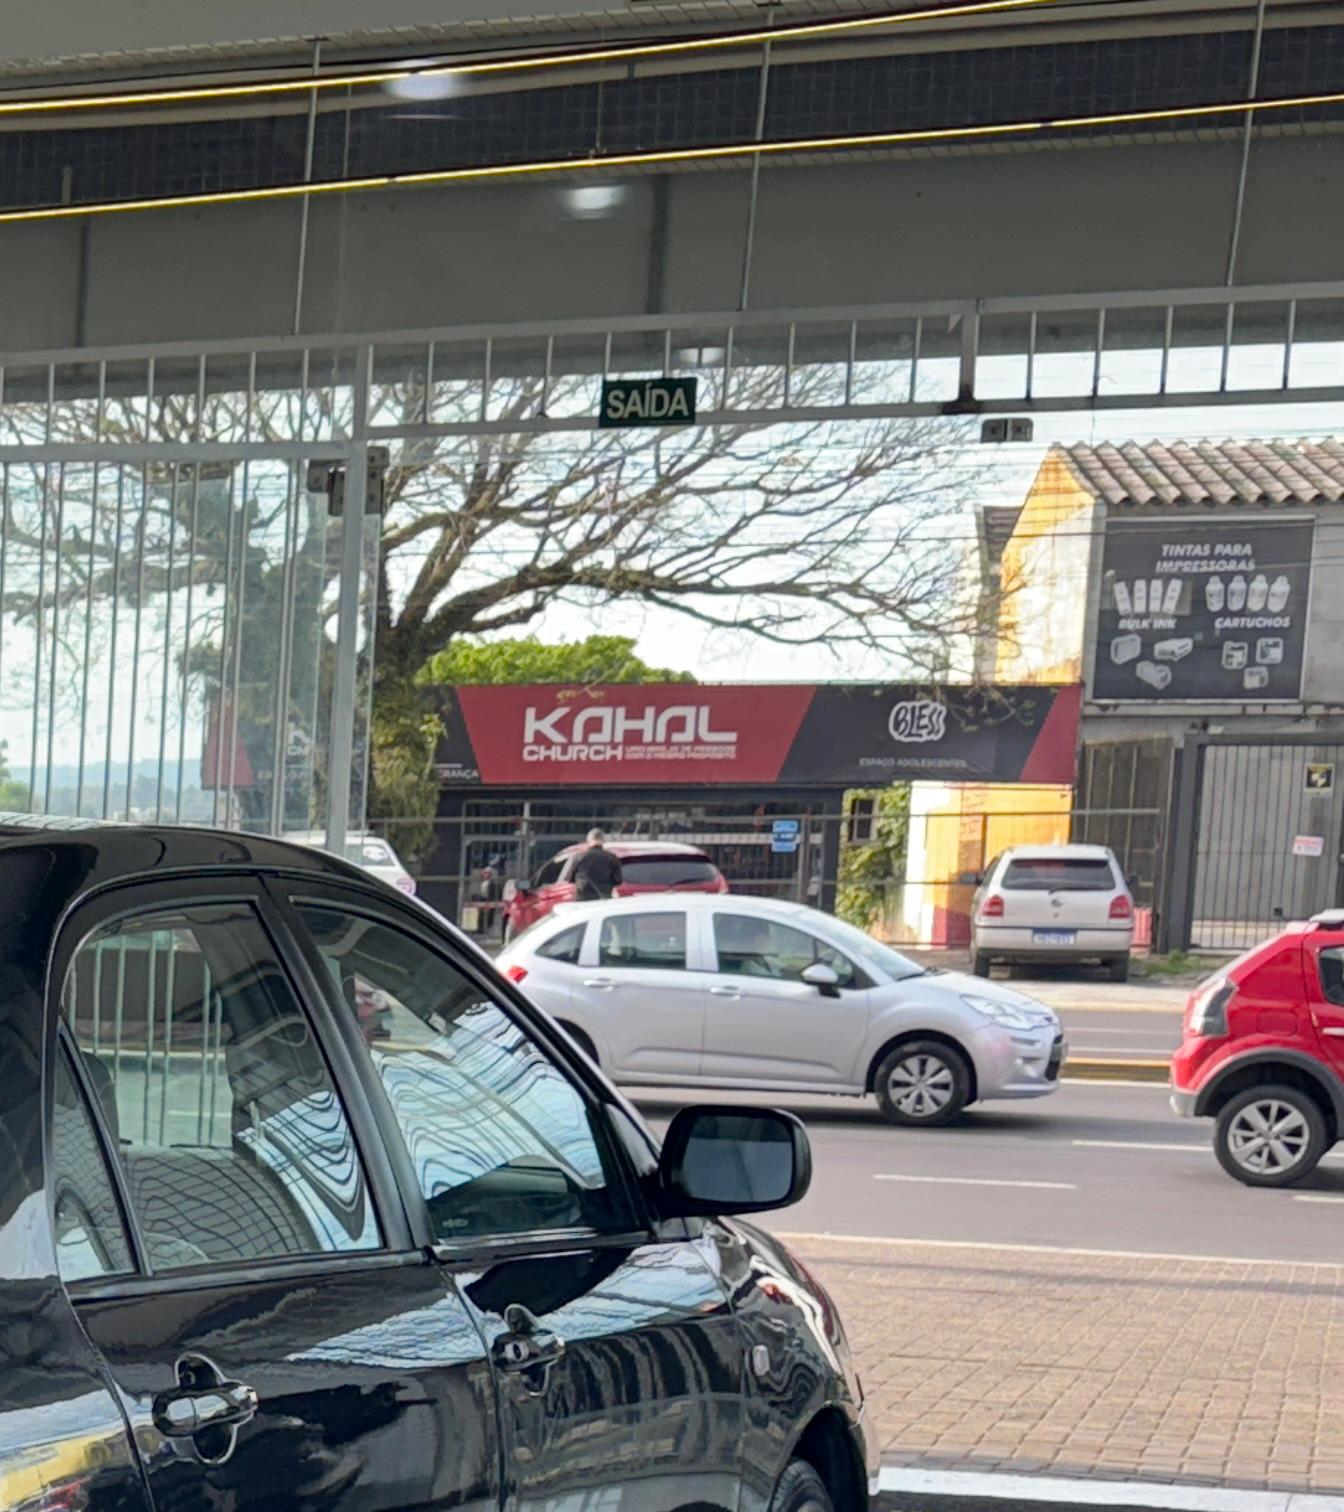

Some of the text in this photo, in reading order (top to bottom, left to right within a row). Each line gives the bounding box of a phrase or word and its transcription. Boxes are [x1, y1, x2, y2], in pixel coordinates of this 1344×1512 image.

[606, 382, 690, 419] SAÍDA
[1161, 543, 1253, 557] TINTAS PARA
[1156, 559, 1255, 573] IMPRESSORAS
[1214, 616, 1291, 629] CARTUCHOS
[523, 705, 739, 744] KAHAL
[522, 743, 623, 762] CHURCH
